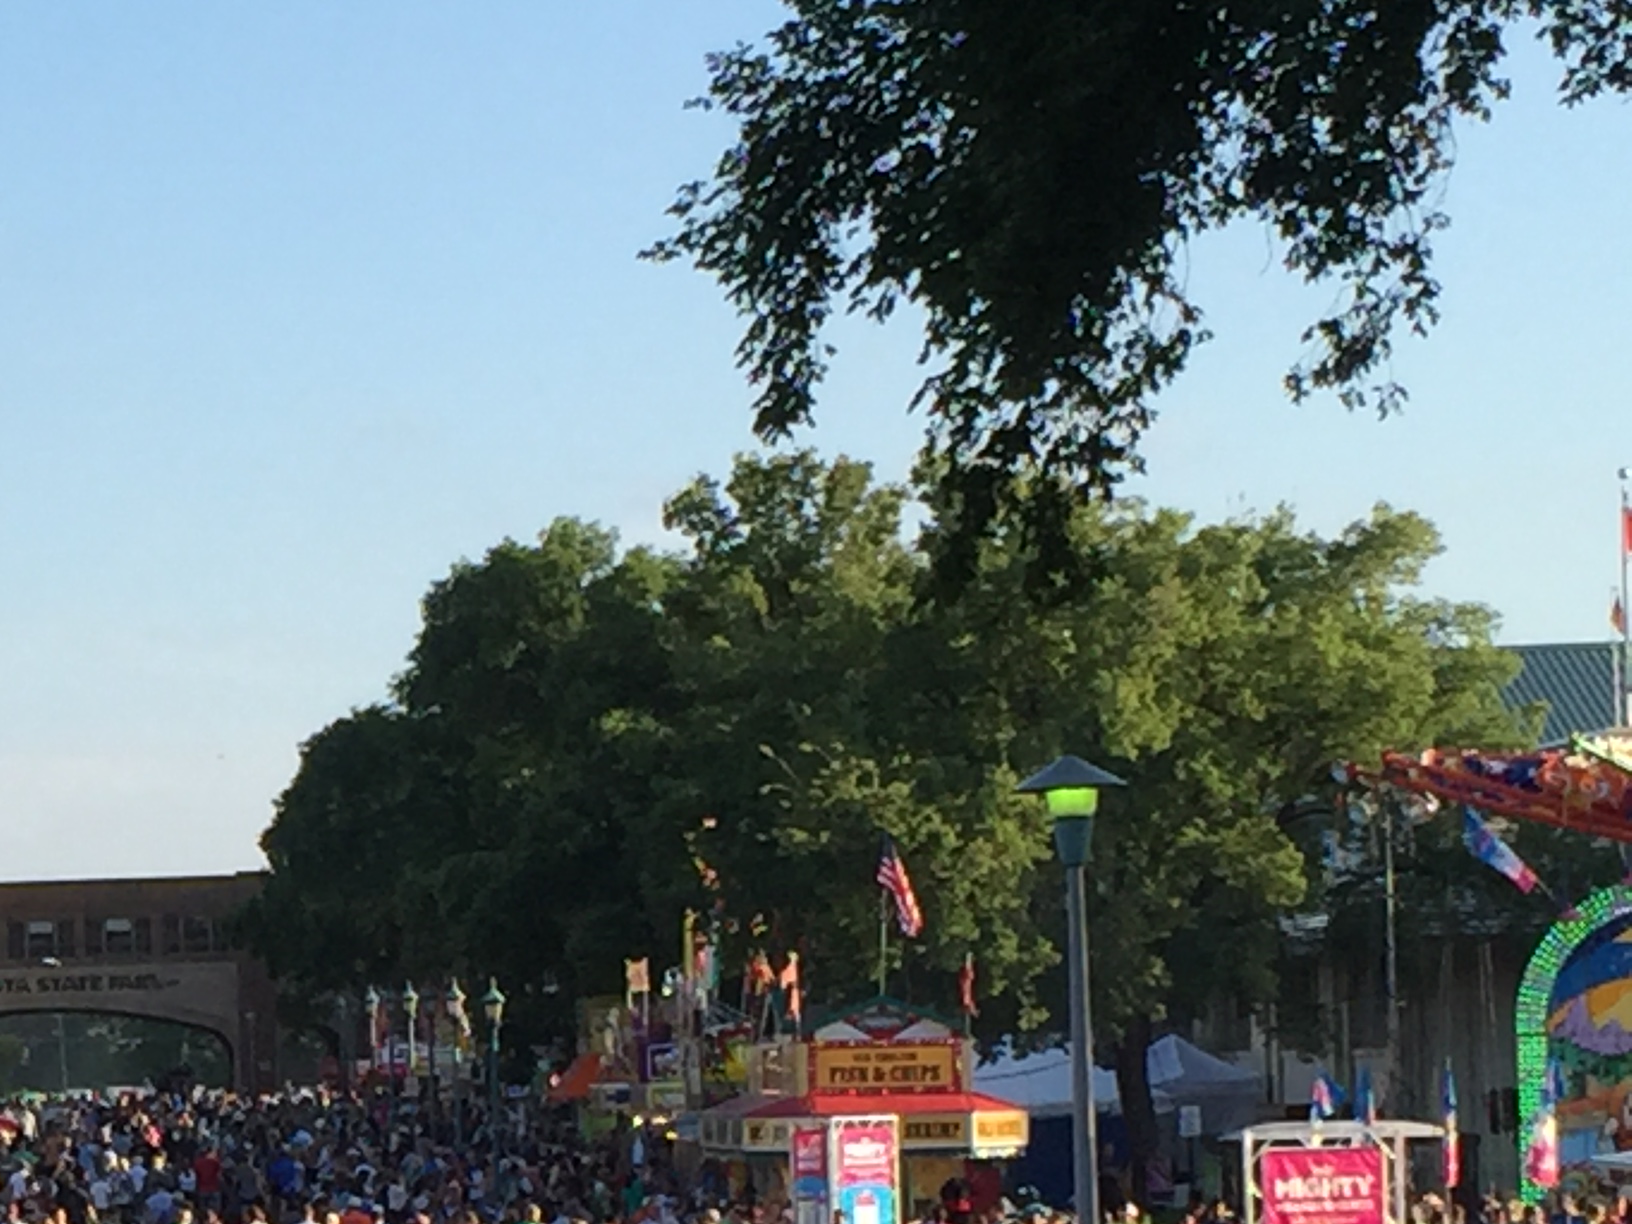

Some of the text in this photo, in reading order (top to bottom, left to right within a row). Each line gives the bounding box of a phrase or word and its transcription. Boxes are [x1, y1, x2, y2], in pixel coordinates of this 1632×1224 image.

[36, 975, 103, 993] STATE
[108, 972, 163, 991] FAIR
[829, 1064, 941, 1083] FISH & CHIPS
[1274, 1175, 1375, 1200] MIGHTY
